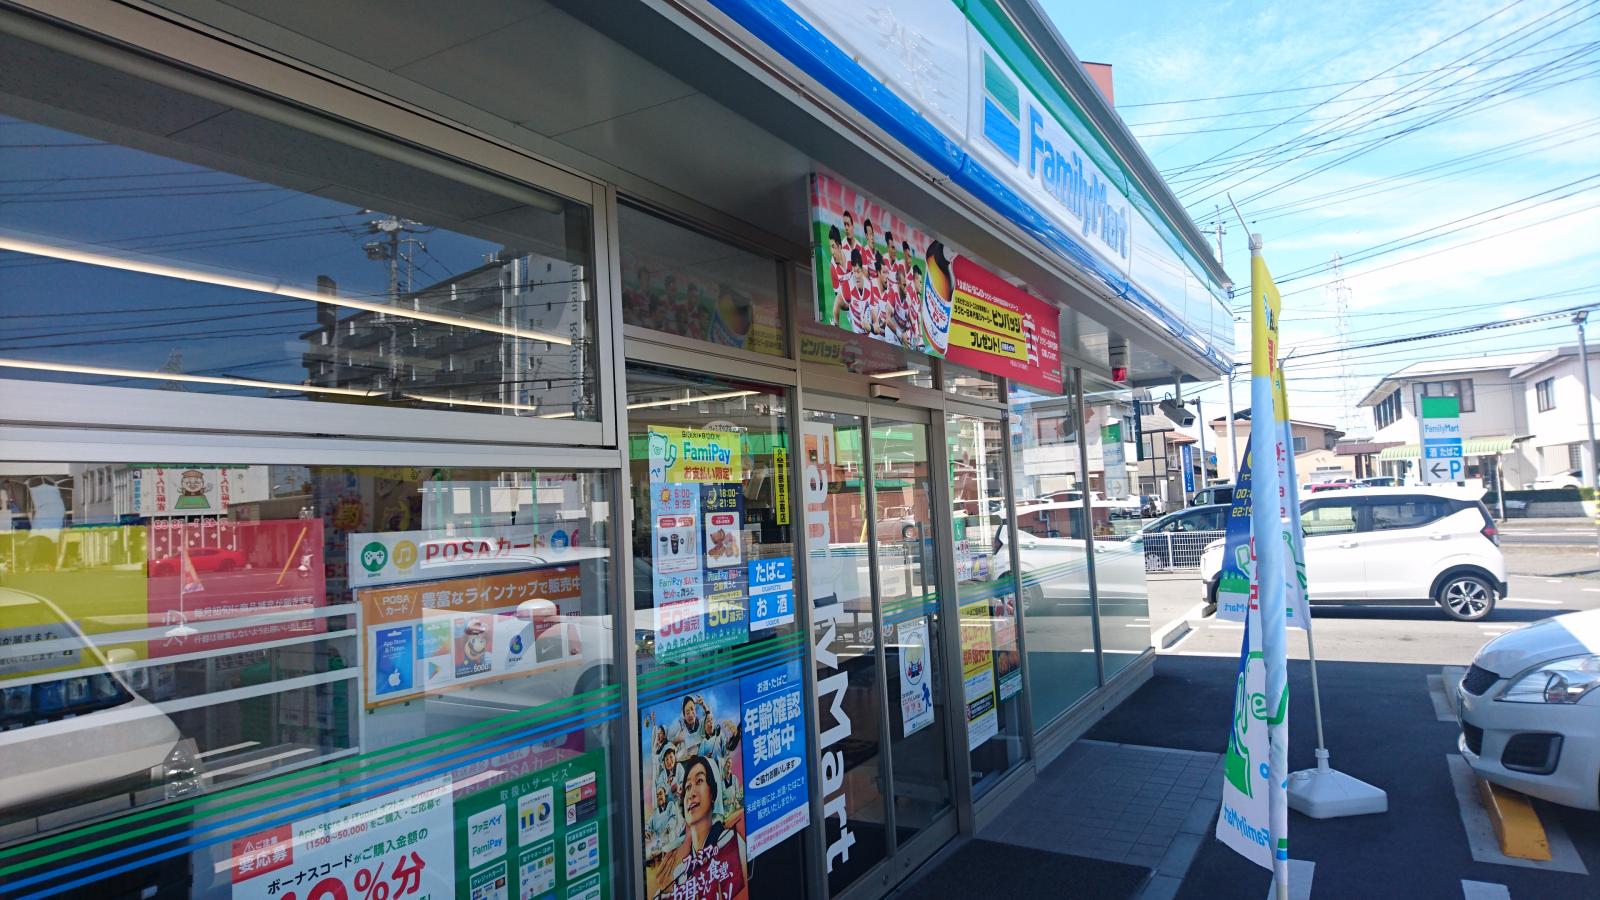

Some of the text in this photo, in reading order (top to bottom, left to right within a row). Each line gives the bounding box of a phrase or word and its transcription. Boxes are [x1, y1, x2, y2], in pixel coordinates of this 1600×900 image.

[1029, 103, 1128, 259] FamilyMart
[991, 309, 1020, 333] ピンバッジ
[1425, 424, 1460, 434] FamilyMart
[683, 441, 731, 464] FamiPay
[1450, 460, 1462, 480] P
[719, 498, 737, 508] 21:59
[425, 534, 546, 561] POSAカード
[755, 561, 786, 583] たばこ
[382, 594, 410, 606] POSA
[421, 576, 581, 609] 豊富なラインナップで販売中
[385, 604, 409, 616] カード
[801, 420, 857, 875] FamlyMart
[744, 690, 801, 736] 年齢確認
[753, 723, 795, 766] 実施中
[500, 768, 569, 801] 取扱いサービス
[471, 814, 502, 835] ファミペイ
[472, 837, 503, 857] FamiPay
[238, 844, 288, 875] 要応募
[267, 827, 429, 896] ボーナスコードがご購入金額の
